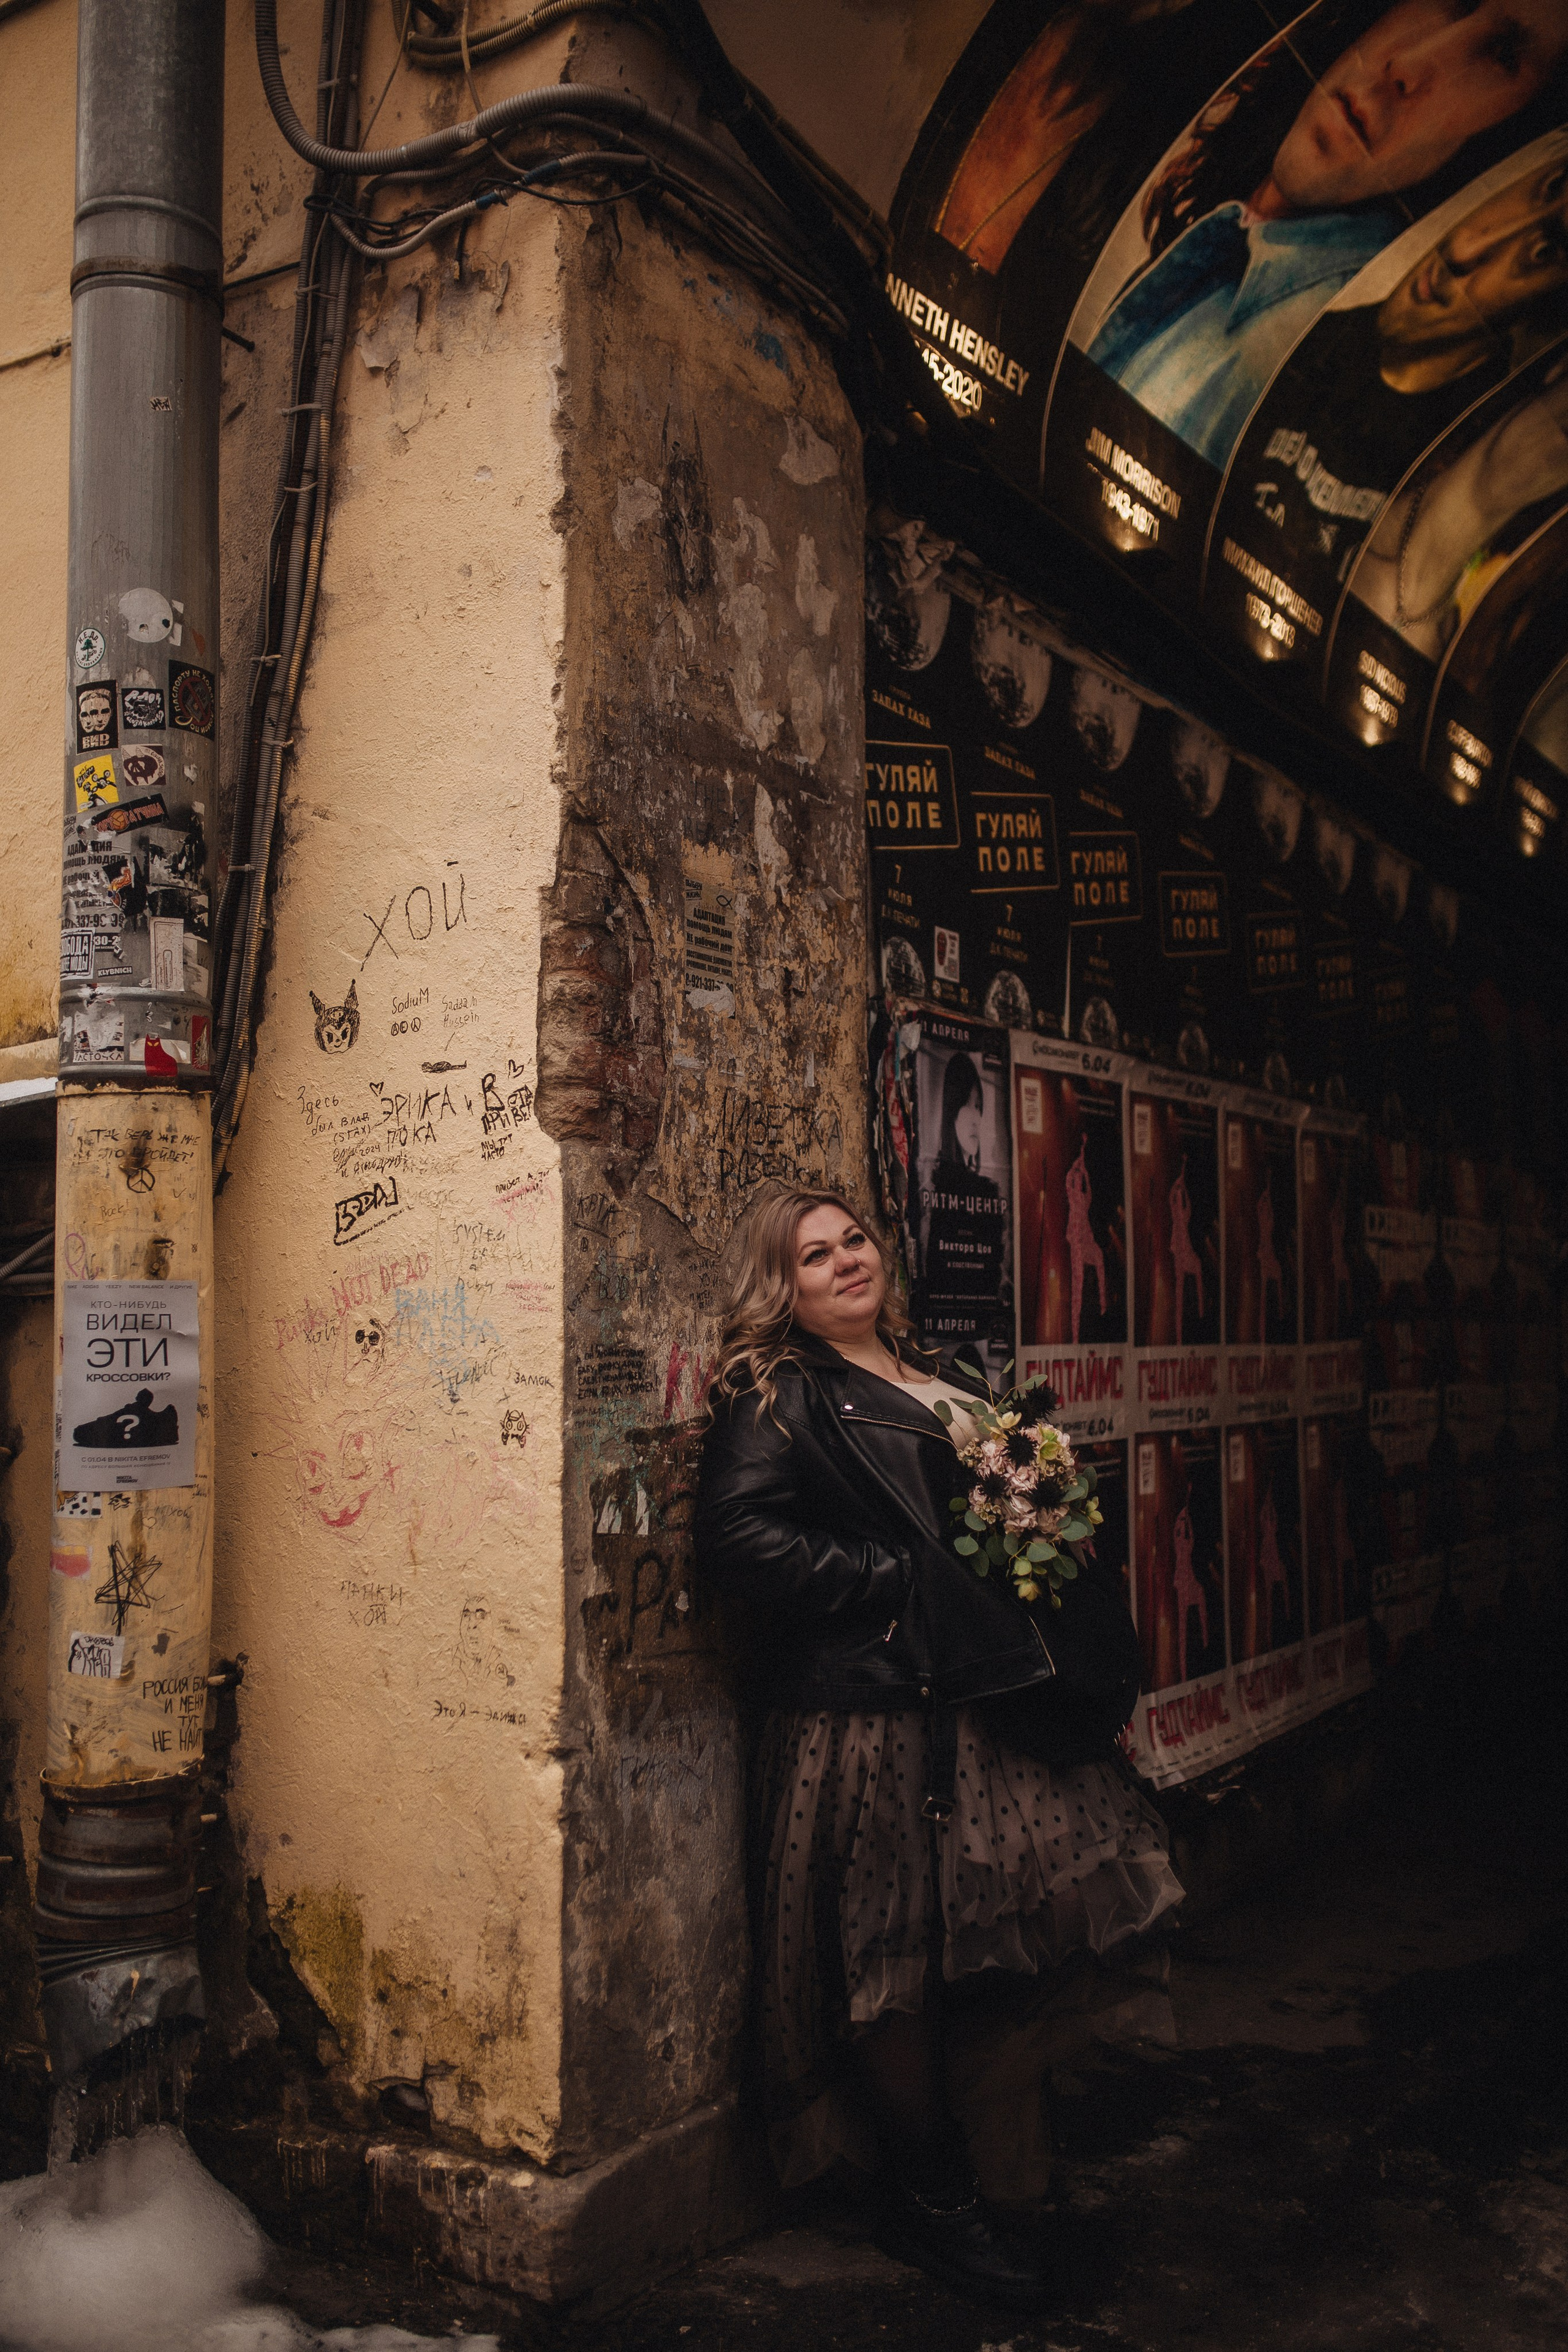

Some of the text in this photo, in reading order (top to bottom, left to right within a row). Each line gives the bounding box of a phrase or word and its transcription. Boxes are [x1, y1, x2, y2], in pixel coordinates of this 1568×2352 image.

[949, 319, 1030, 396] HENSLEY
[1085, 427, 1182, 519] JIM MORRISON
[1101, 477, 1161, 542] 1943-1971
[172, 670, 190, 712] ПАСПОРТУ
[82, 733, 110, 749] ВИД
[865, 759, 938, 793] ГУЛЯЙ
[122, 802, 165, 825] ГАТЧИНА
[866, 799, 943, 829] ПОЛЕ
[975, 807, 1042, 839] ГУЛЯЙ
[978, 846, 1046, 873] ПОЛЕ
[1069, 844, 1129, 875] ГУЛЯЙ
[1073, 880, 1131, 907] ПОЛЕ
[1170, 883, 1219, 912] ГУЛЯЙ
[360, 860, 467, 972] ХОЙ
[693, 907, 726, 926] АДАПТАЦИЯ
[687, 919, 733, 940] ПОМОЩЬ ЛЮДЯМ
[1172, 916, 1220, 940] ПОЛЕ
[687, 932, 694, 942] НЕ
[694, 936, 720, 949] рабочий
[97, 965, 132, 978] KLYBNICH
[931, 1024, 970, 1041] АПРЕЛЯ
[1081, 1052, 1112, 1074] 6.04
[297, 1085, 339, 1125] Здесь
[922, 1191, 1008, 1216] РИТМ-ЦЕНТР
[938, 1239, 974, 1254] Виктора
[91, 1300, 167, 1310] КТО-НИБУДЬ
[86, 1313, 172, 1333] ВИДЕЛ
[925, 1318, 976, 1332] 11 АПРЕЛЯ
[86, 1337, 169, 1368] ЭТИ
[86, 1372, 171, 1383] КРОССОВКИ?
[143, 1676, 188, 1699] РОССИЯ
[164, 1694, 204, 1714] И МЕНЯ
[176, 1716, 200, 1733] ТУТ
[152, 1730, 172, 1752] НЕ
